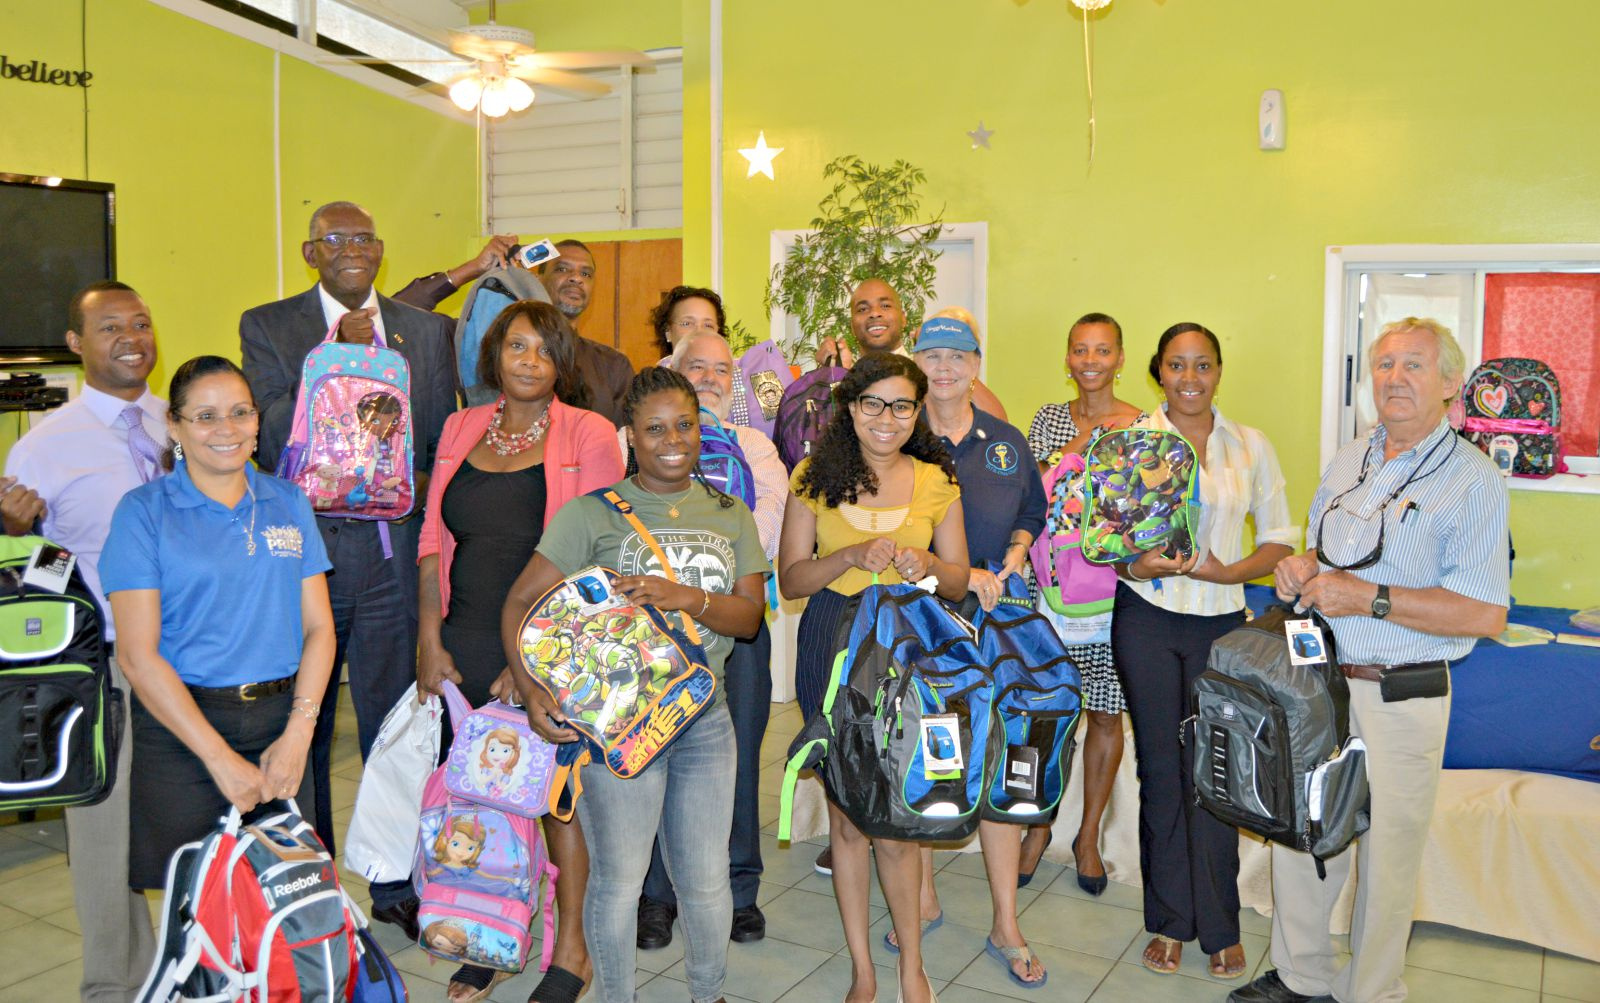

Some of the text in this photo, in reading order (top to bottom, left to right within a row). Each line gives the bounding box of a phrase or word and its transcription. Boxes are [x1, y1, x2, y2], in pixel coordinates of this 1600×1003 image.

[0, 55, 93, 88] believe
[658, 535, 688, 543] THE
[273, 872, 322, 898] Reebok
